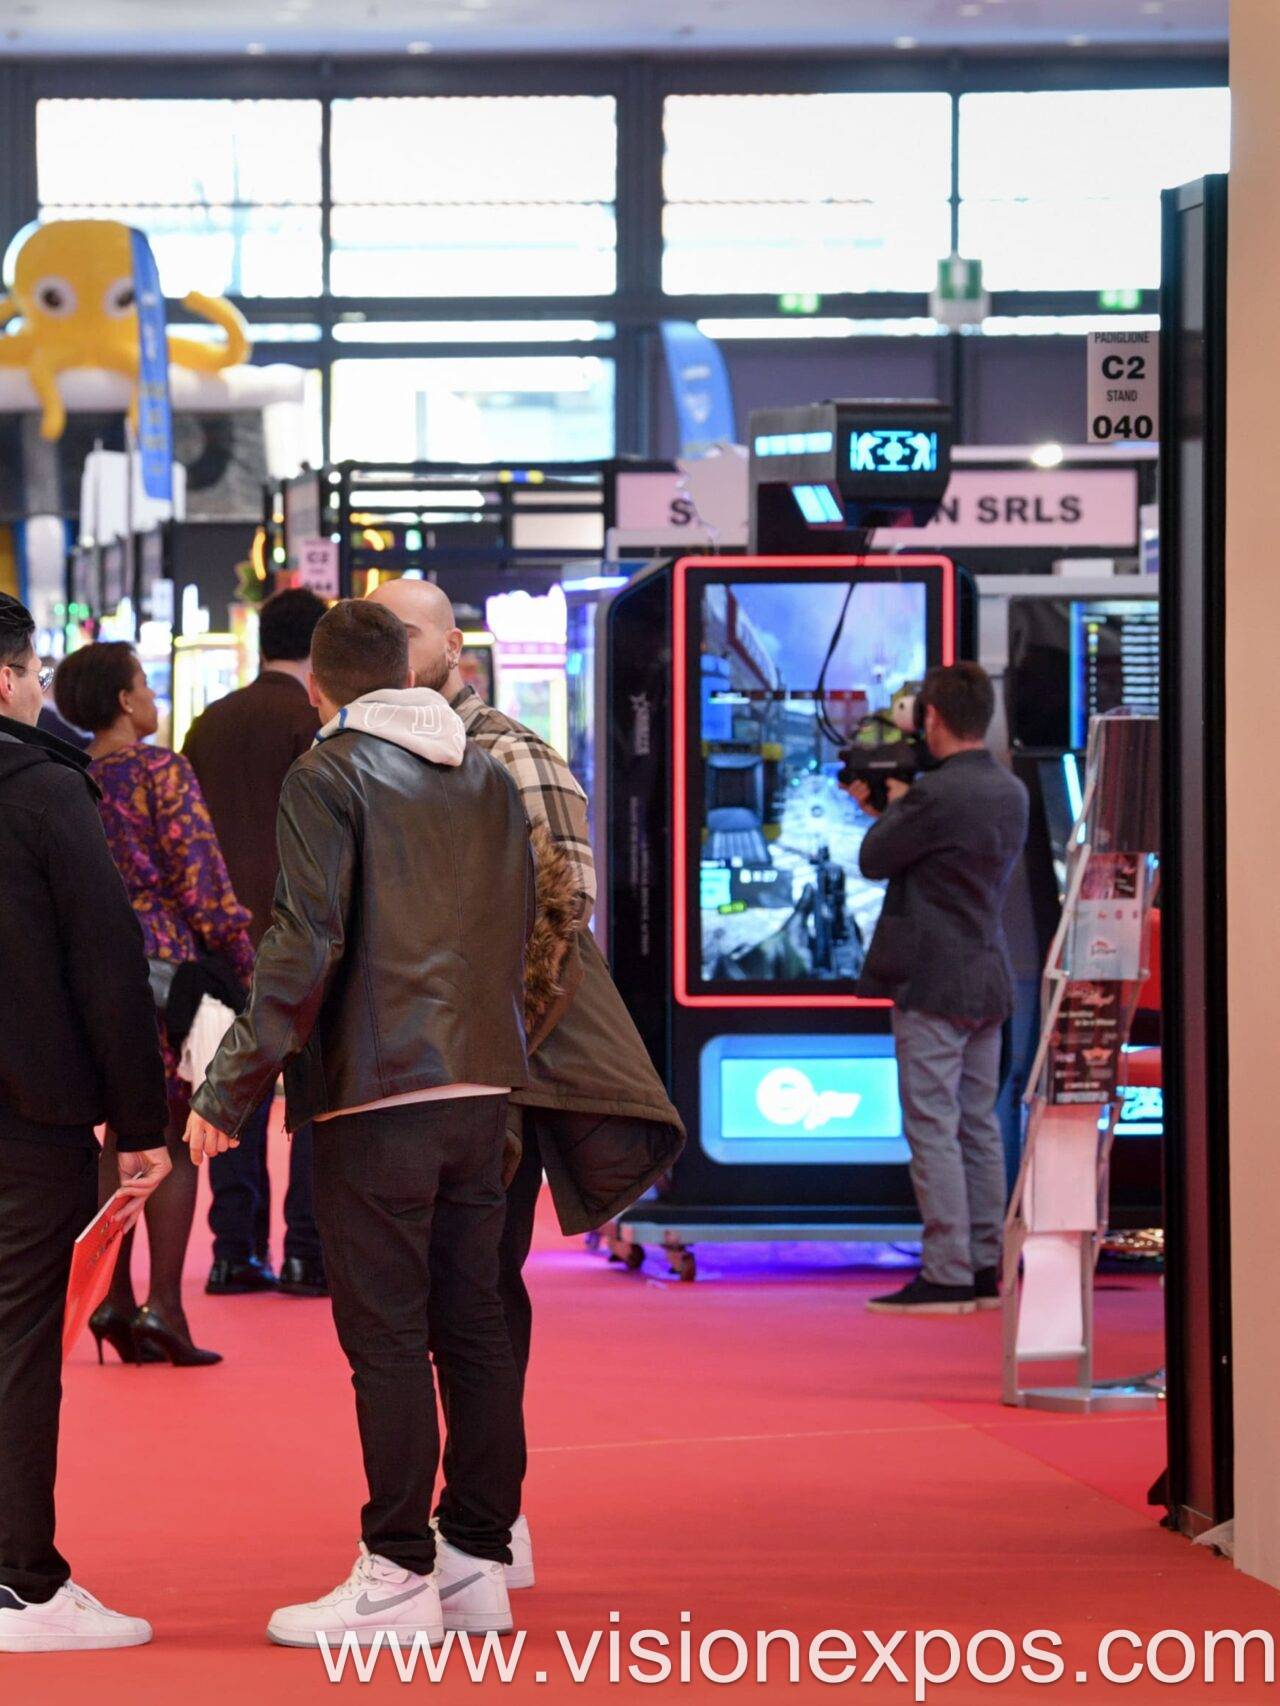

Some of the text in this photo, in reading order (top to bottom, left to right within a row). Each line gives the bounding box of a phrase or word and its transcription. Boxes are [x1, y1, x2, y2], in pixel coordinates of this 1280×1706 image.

[1094, 332, 1150, 343] PADIGLIONE
[1102, 355, 1146, 379] C2
[1106, 389, 1138, 402] STAND
[1093, 415, 1153, 439] 040
[976, 495, 1082, 523] SRLS
